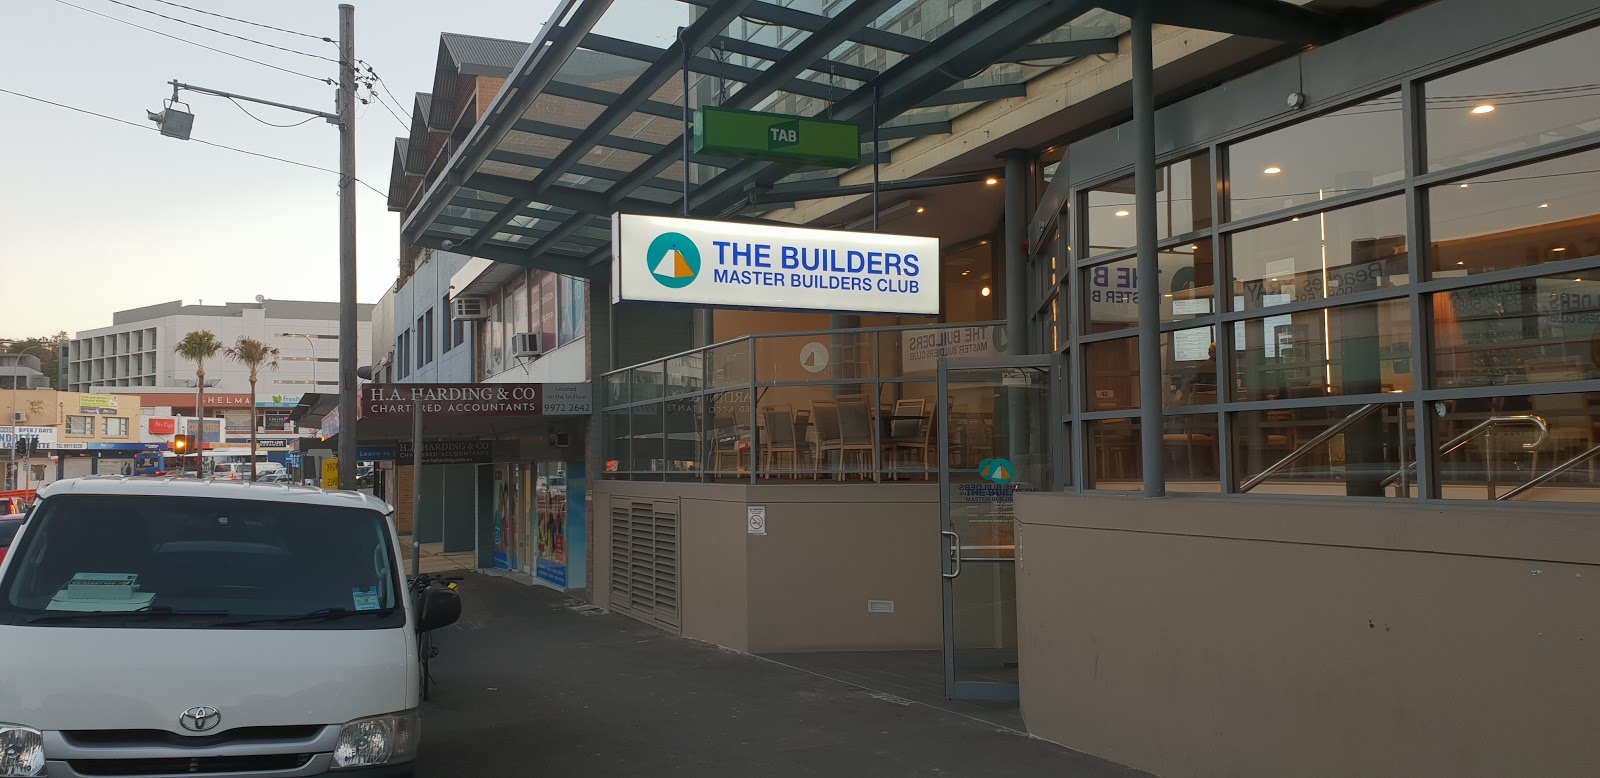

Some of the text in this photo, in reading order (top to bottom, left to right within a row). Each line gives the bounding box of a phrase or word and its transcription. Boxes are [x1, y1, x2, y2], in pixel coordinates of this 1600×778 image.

[770, 127, 797, 143] TAB
[713, 240, 920, 277] THE BUILDERS
[713, 269, 920, 294] MASTER BUILDERS CLUB
[371, 387, 536, 401] H.A. HARDING & CO
[371, 402, 536, 413] CHARTRED ACCOUNTANTS
[544, 403, 591, 412] 9972 2642
